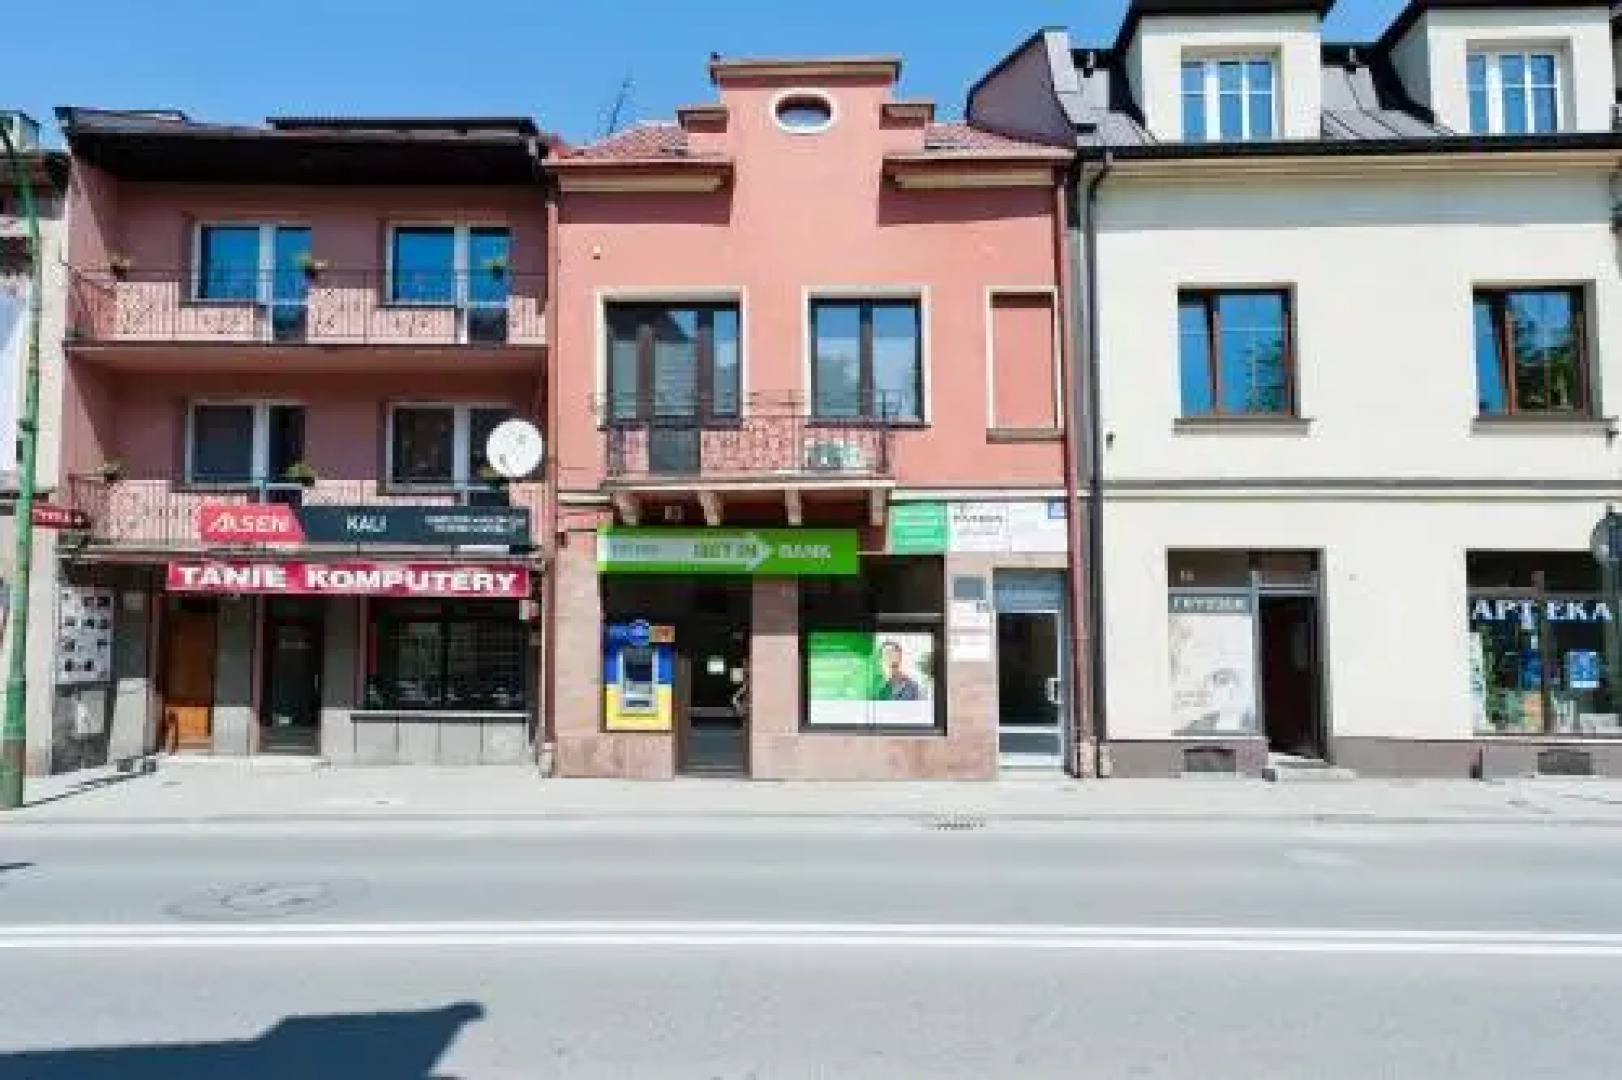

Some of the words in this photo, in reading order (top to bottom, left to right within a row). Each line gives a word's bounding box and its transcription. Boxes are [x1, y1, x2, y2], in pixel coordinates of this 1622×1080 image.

[207, 512, 289, 532] ALSEN
[178, 566, 287, 588] TANIE
[307, 569, 519, 591] KOMPUTERY
